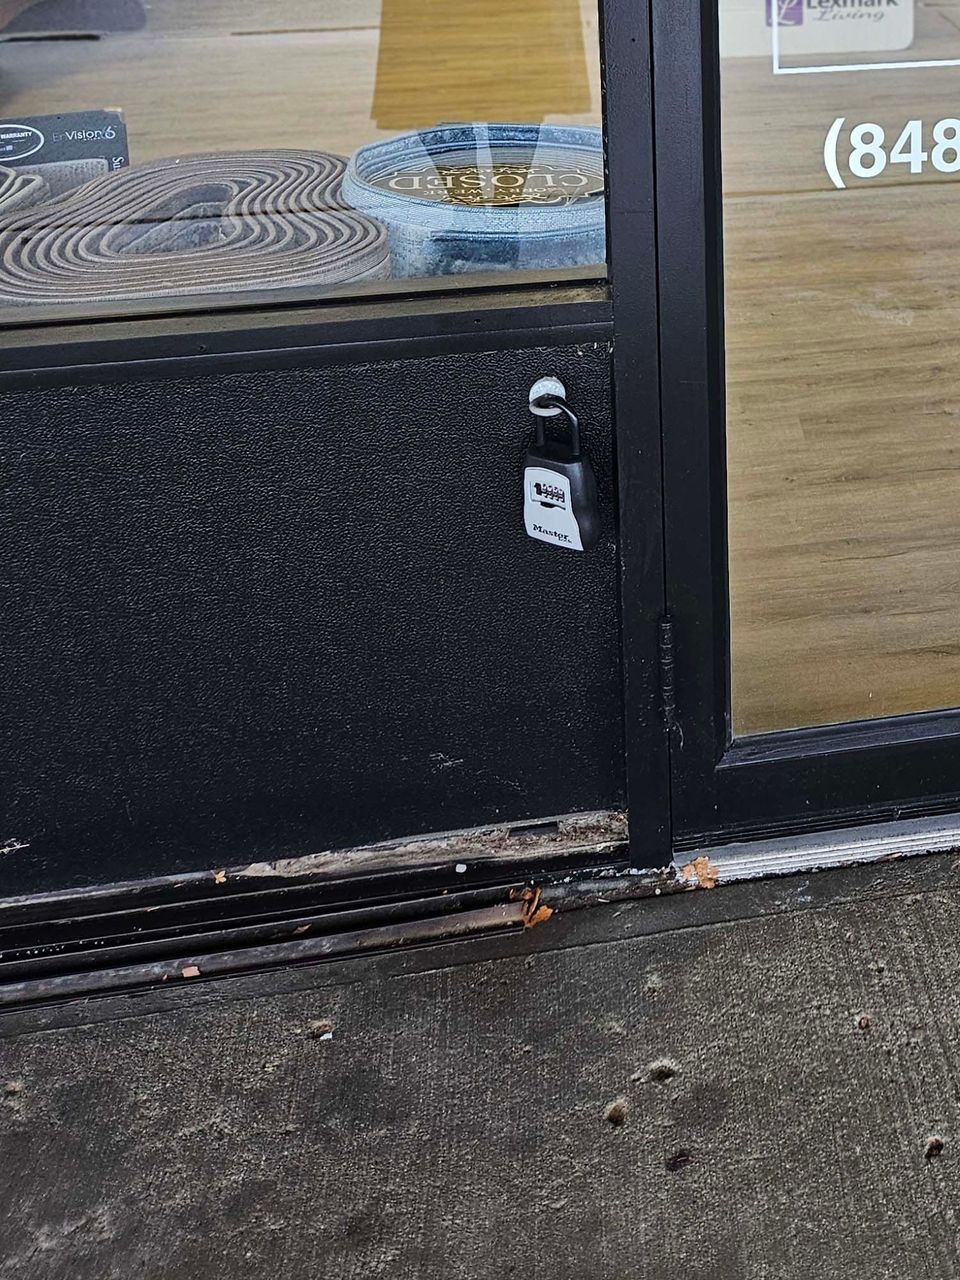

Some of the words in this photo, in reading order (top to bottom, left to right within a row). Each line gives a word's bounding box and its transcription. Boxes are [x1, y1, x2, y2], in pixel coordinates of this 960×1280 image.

[812, 7, 885, 22] Living
[388, 174, 589, 190] CLOSED
[532, 523, 569, 540] Master
